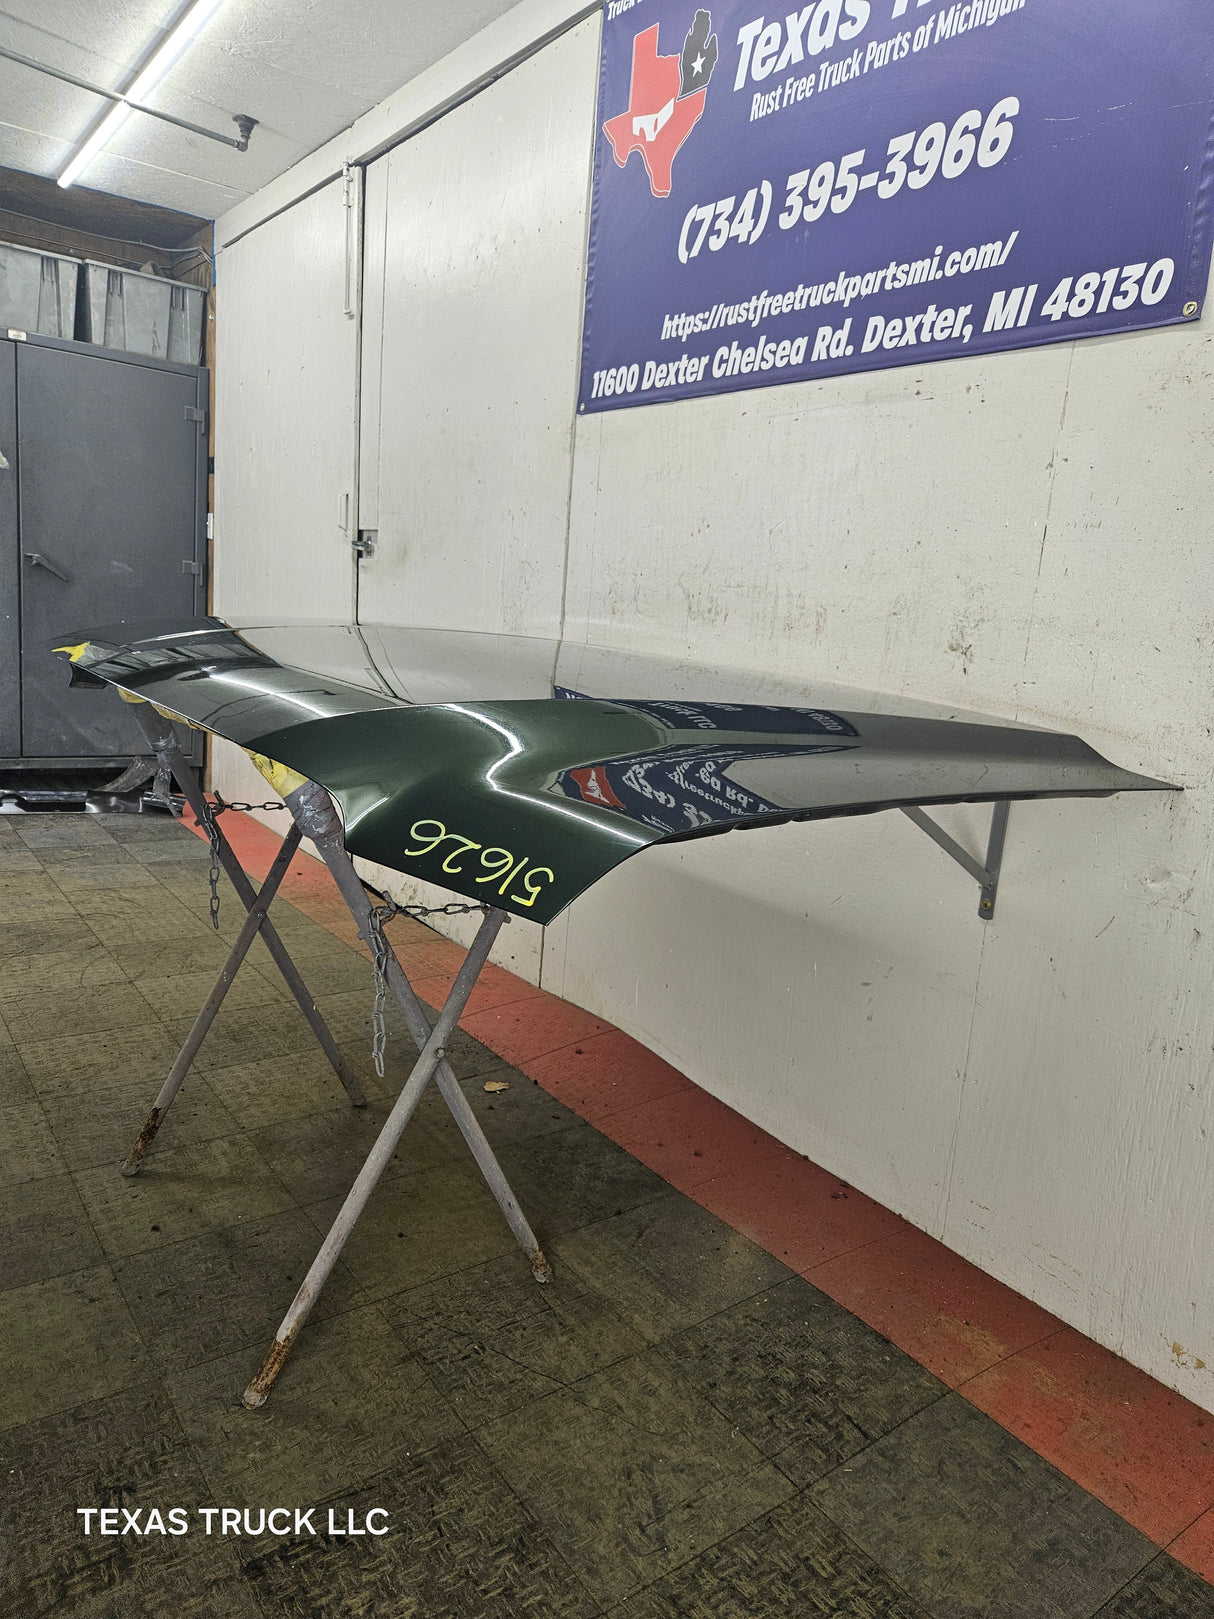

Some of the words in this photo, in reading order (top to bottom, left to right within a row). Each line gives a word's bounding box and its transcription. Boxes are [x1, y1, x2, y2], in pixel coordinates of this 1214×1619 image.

[733, 0, 871, 92] Texas
[749, 84, 783, 122] Rust
[782, 69, 815, 106] Free
[818, 48, 863, 93] Truck
[863, 31, 911, 74] Parts
[912, 13, 934, 52] of
[678, 180, 772, 264] (734)
[779, 96, 1020, 230] 395-3966
[591, 363, 639, 399] 11600
[641, 354, 709, 391] Dexter
[712, 335, 808, 379] Chelsea
[811, 318, 853, 361] Rd.
[861, 304, 973, 353] Dexter,
[983, 284, 1038, 333] MI
[1041, 257, 1174, 321] 48130
[661, 230, 1020, 342] https://rustfreetruckpartsmi.com/
[404, 819, 554, 907] 51626
